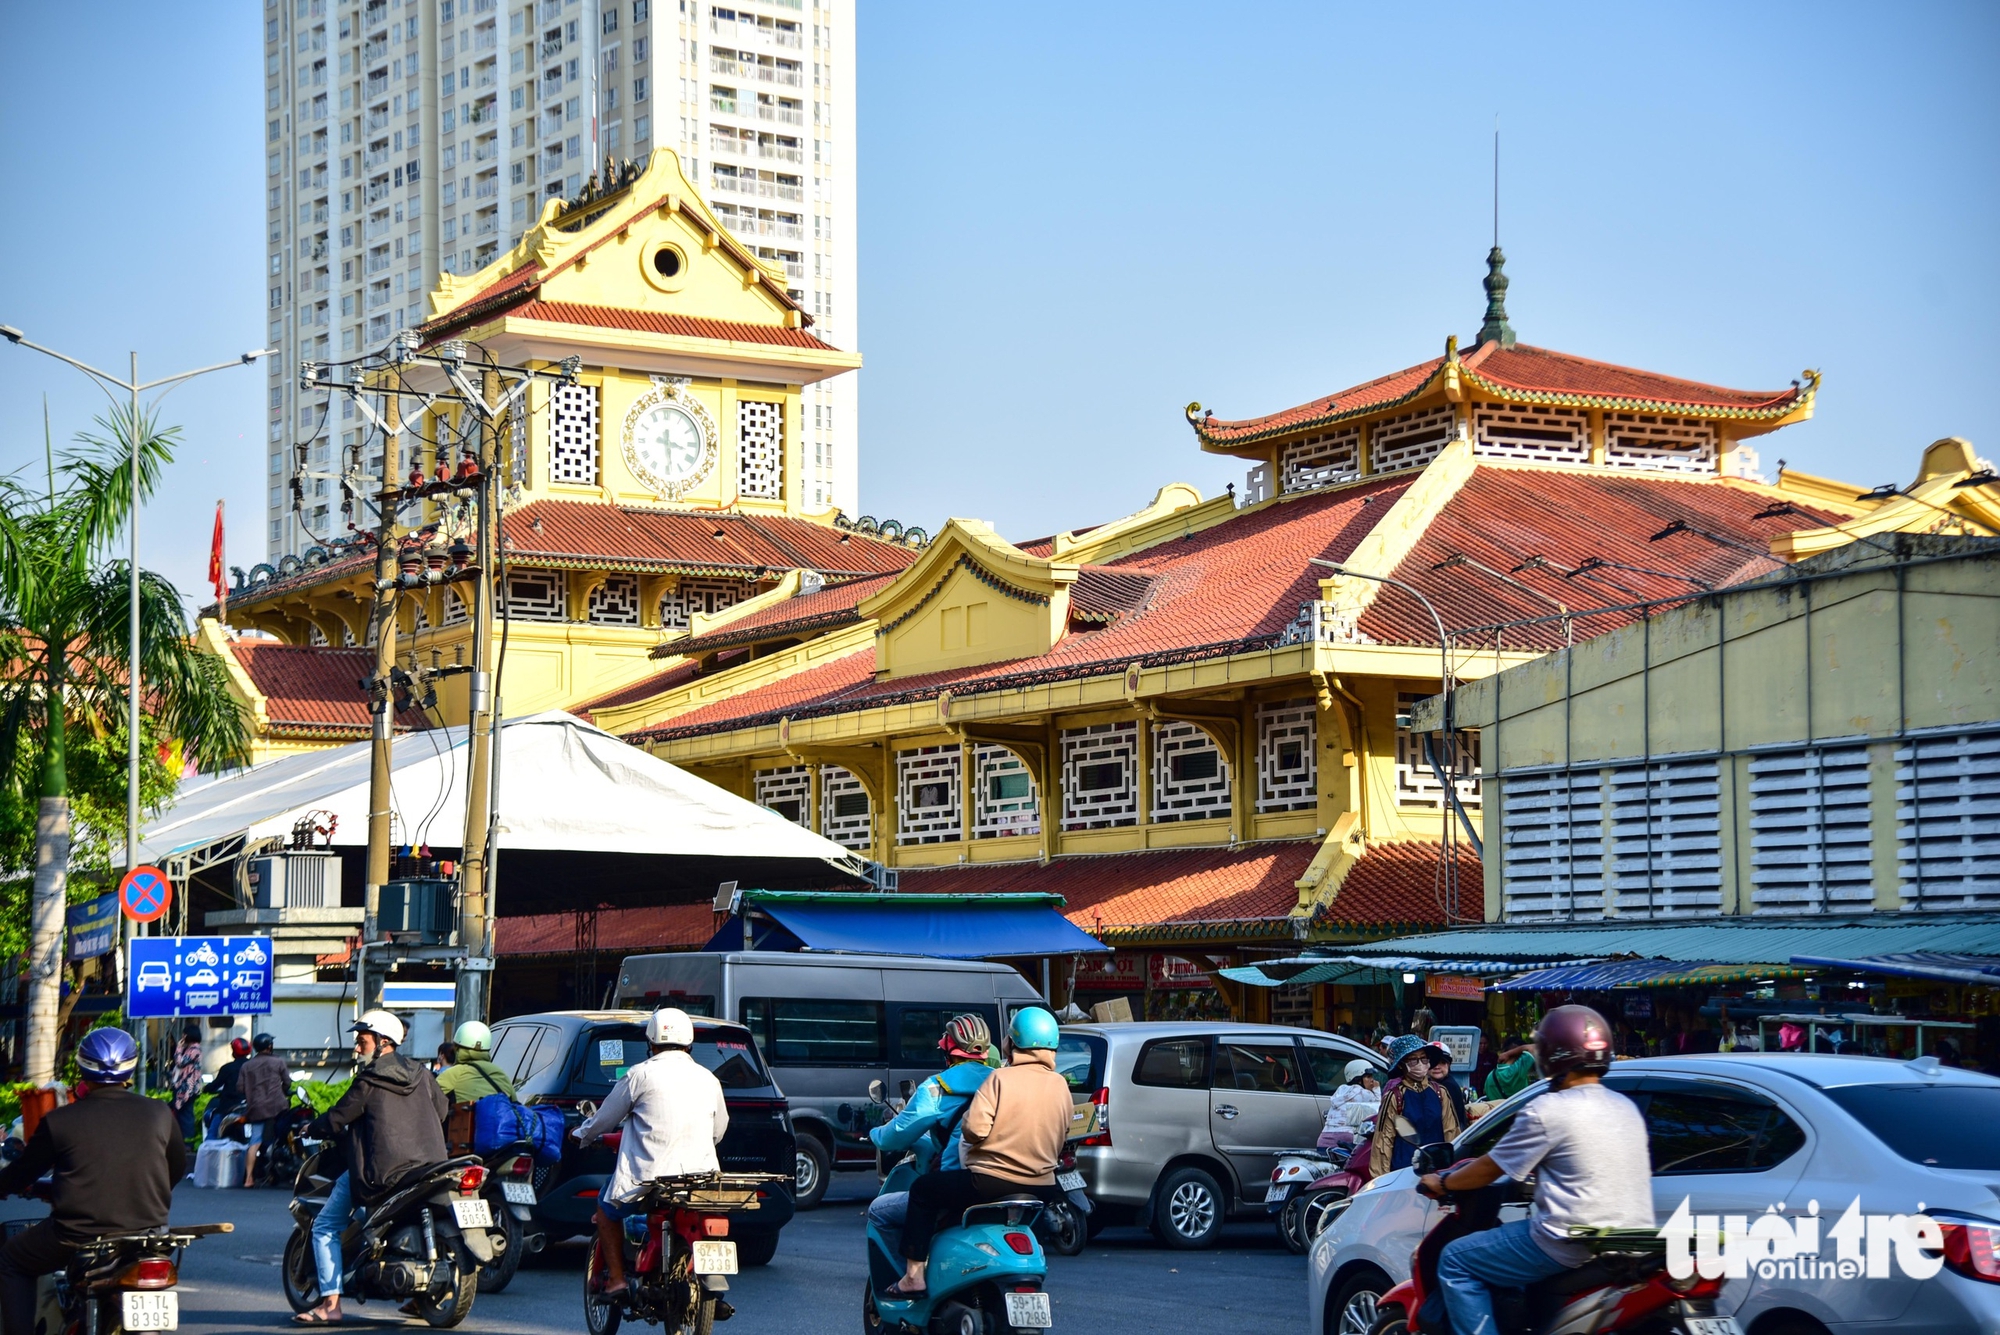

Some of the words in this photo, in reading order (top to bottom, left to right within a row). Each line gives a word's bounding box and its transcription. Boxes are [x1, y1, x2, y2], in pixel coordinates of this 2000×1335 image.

[239, 991, 248, 1000] XE
[250, 991, 261, 1000] 02
[462, 1213, 487, 1225] 9059
[700, 1257, 731, 1271] 7339
[131, 1294, 169, 1310] 51-T4
[132, 1312, 170, 1328] 8395
